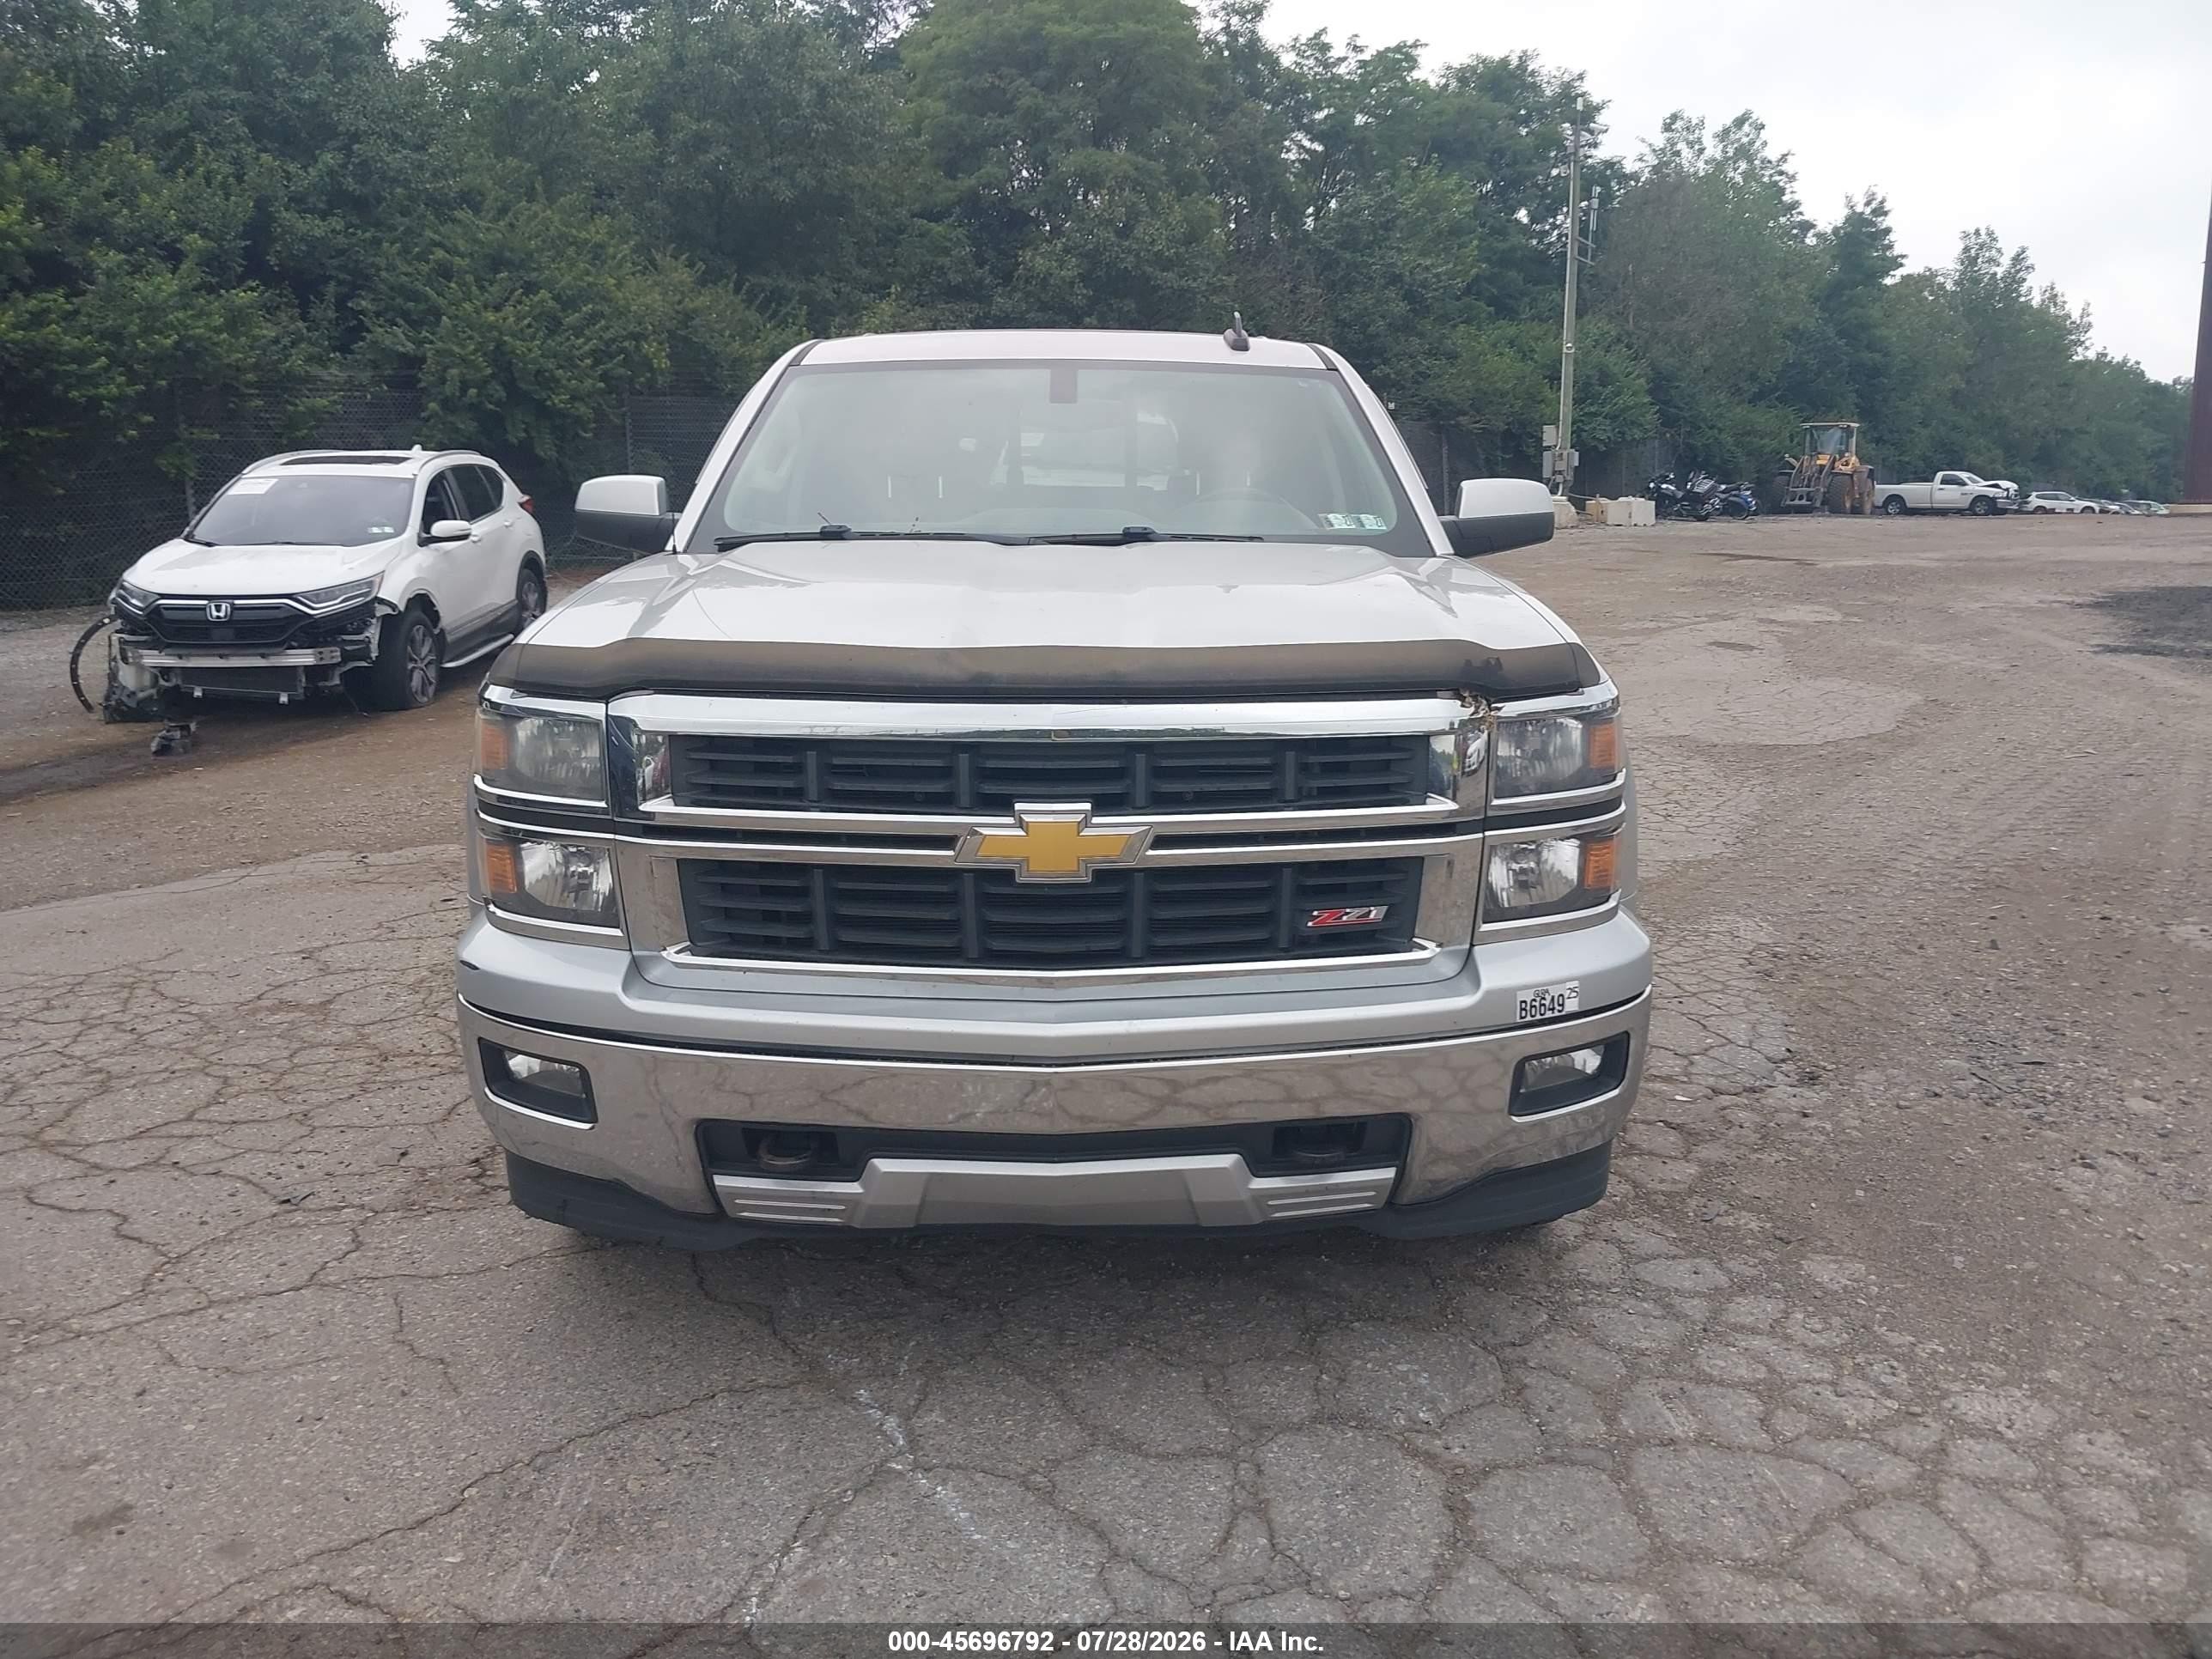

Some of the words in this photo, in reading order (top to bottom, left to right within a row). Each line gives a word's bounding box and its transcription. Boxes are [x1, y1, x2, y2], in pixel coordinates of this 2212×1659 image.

[1306, 905, 1389, 927] Z71
[1565, 986, 1579, 1000] 25
[1519, 994, 1565, 1020] B6649
